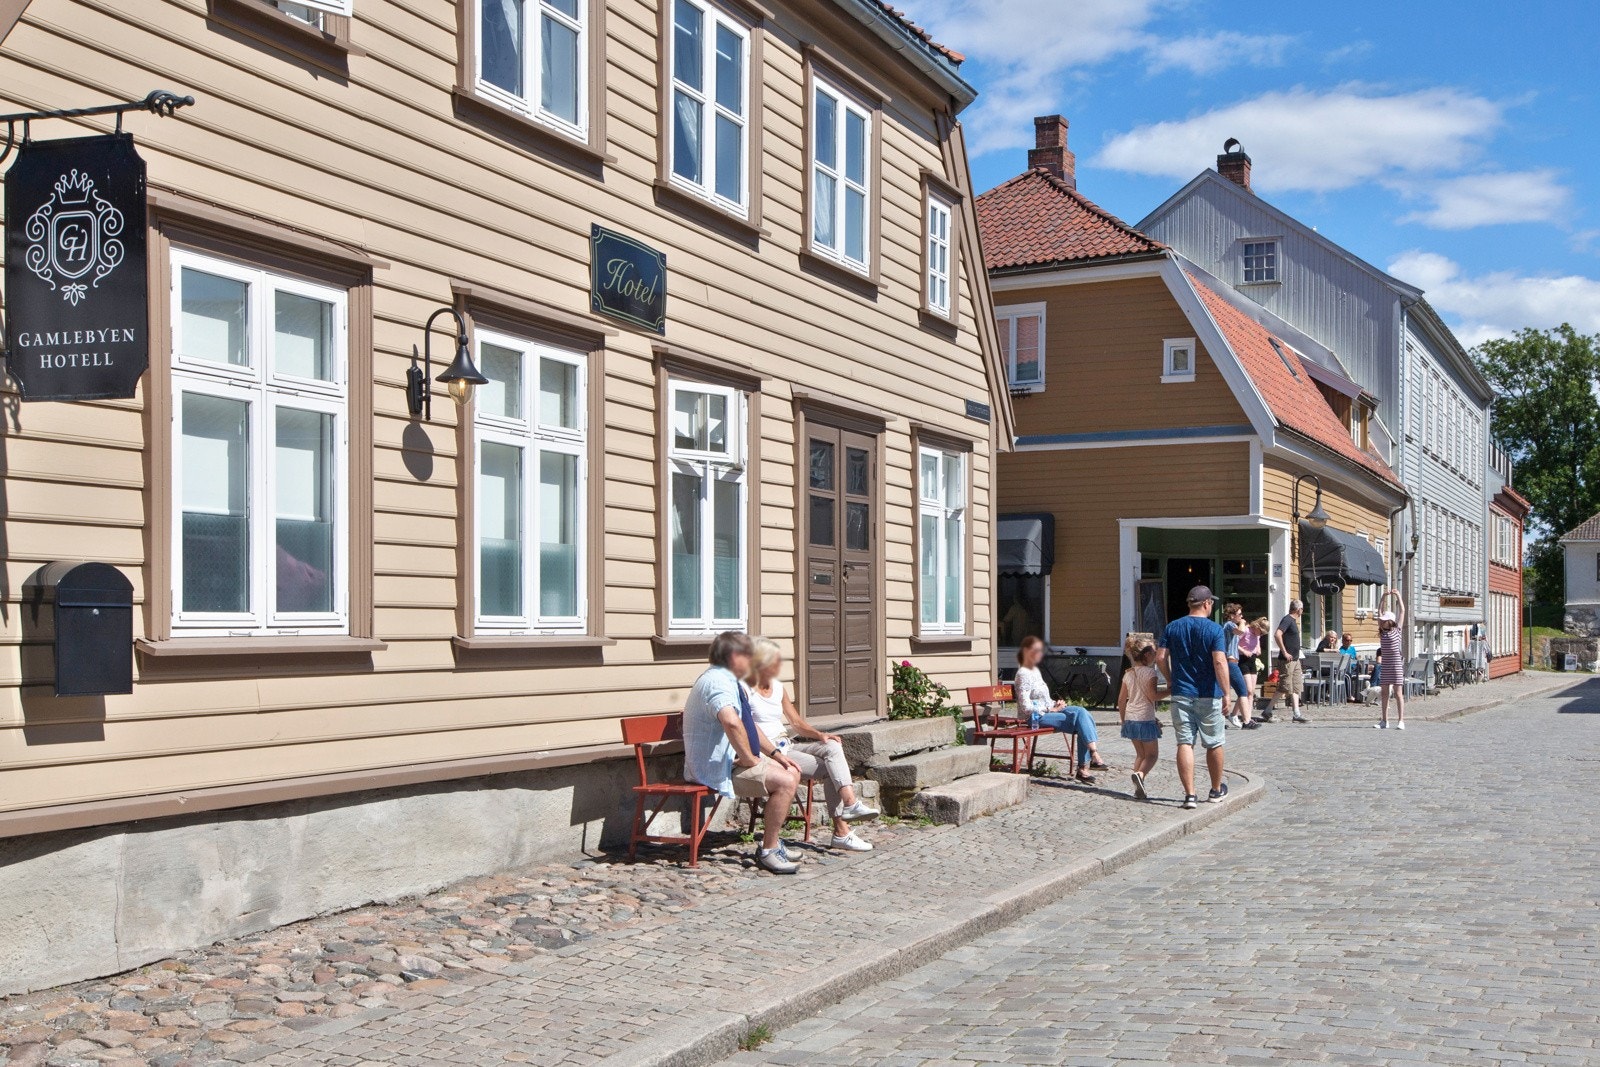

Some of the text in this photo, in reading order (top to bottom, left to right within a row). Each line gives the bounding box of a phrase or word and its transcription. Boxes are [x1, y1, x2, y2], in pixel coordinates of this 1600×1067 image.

[603, 258, 659, 306] Hotel
[18, 328, 135, 347] GAMLEBYEN
[40, 352, 114, 369] HOTELL
